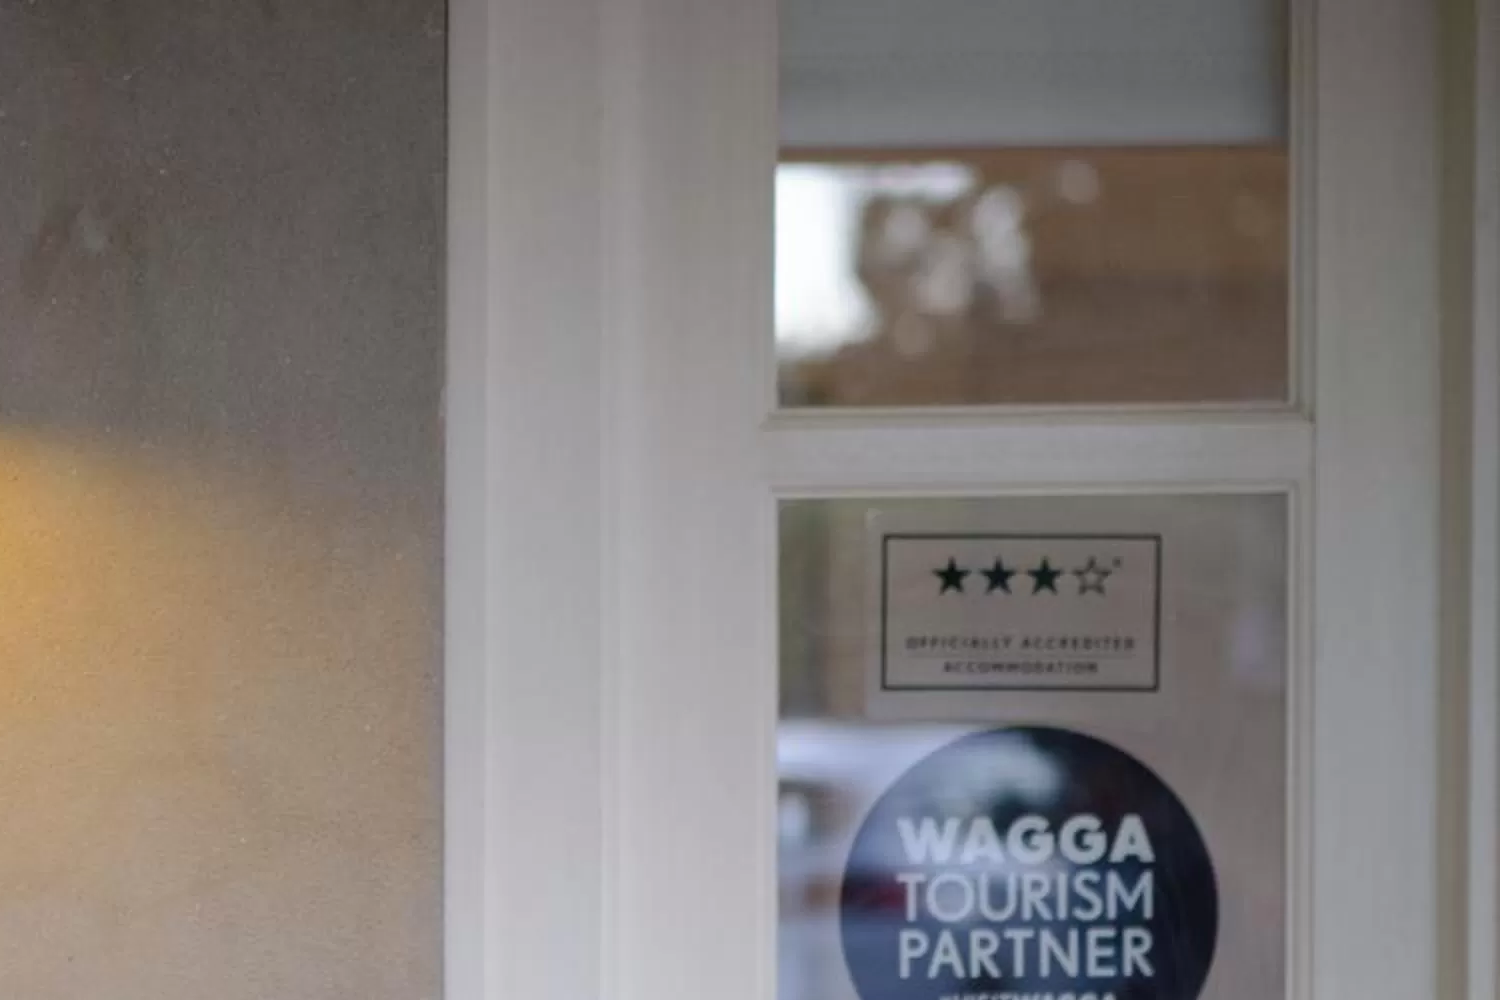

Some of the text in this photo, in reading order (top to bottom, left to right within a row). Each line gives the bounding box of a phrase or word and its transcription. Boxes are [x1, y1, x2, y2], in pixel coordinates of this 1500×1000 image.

[897, 813, 1156, 864] WAGGA
[896, 870, 1155, 922] TOURISM
[899, 928, 1155, 979] PARTNER
